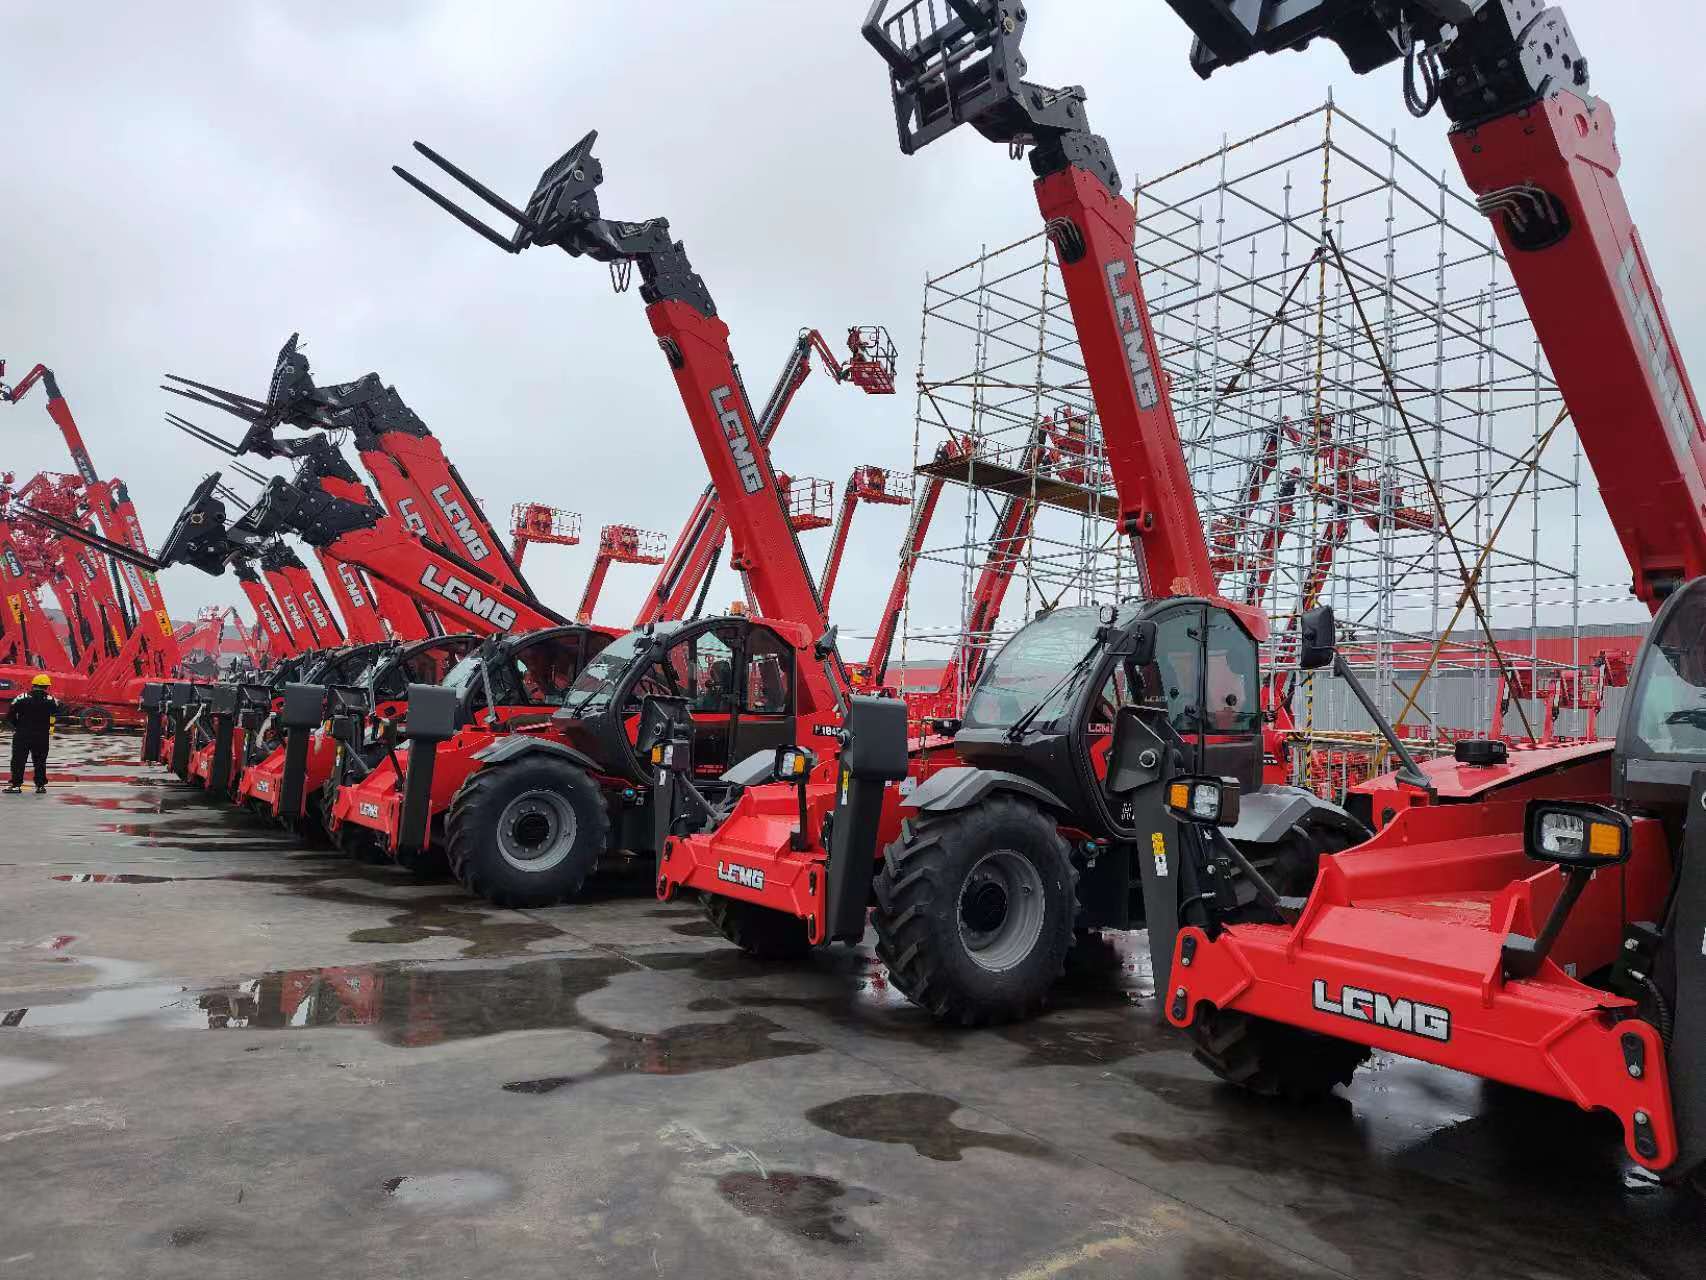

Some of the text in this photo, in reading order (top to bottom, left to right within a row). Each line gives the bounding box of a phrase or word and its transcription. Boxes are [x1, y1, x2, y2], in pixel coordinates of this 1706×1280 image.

[1105, 260, 1158, 409] LGMG
[709, 385, 765, 493] LGMG
[432, 485, 491, 561] LGMG
[337, 563, 365, 608] LGMG
[420, 564, 518, 631] LGMG
[718, 860, 765, 891] LGMG
[1314, 979, 1451, 1042] LGMG
